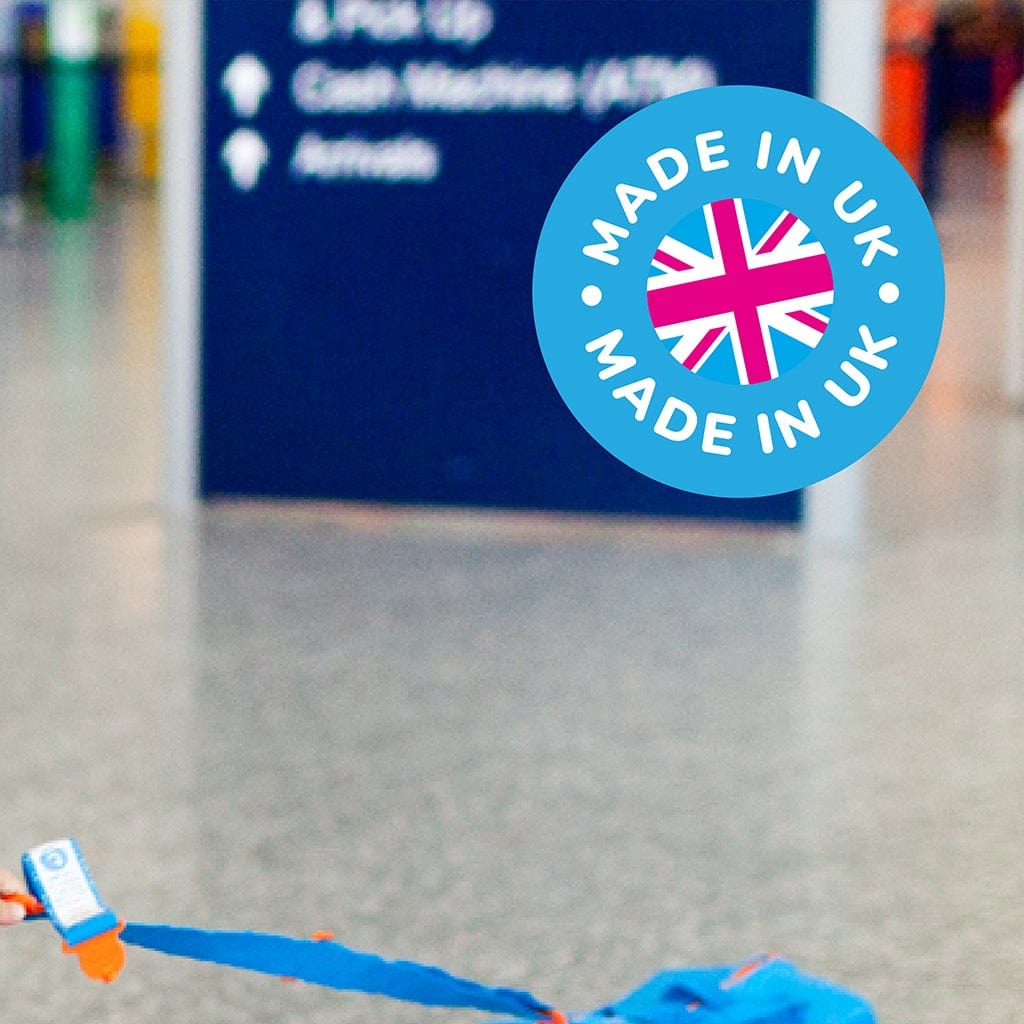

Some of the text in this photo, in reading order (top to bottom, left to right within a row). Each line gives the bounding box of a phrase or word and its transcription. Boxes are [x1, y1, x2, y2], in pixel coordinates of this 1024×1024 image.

[293, 60, 397, 112] Cash
[403, 60, 576, 112] Machine
[291, 132, 440, 181] Arrivals
